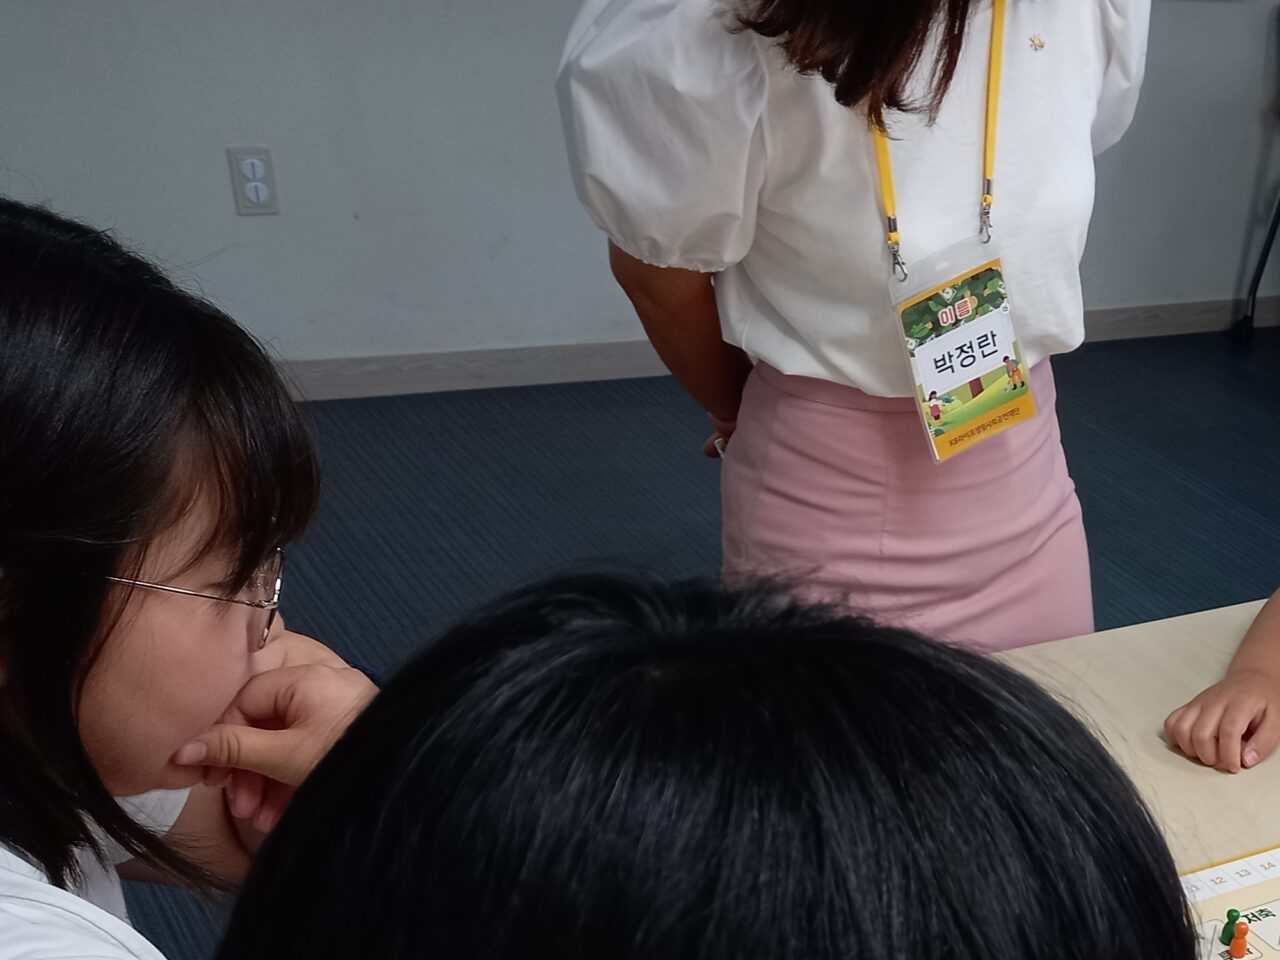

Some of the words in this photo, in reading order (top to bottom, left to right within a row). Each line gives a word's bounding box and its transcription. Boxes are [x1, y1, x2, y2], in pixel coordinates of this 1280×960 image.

[938, 298, 972, 326] 이름
[933, 330, 999, 375] 박정란
[1235, 868, 1252, 878] 13
[1260, 862, 1276, 871] 14
[1210, 876, 1227, 886] 12
[1241, 907, 1277, 924] 저축
